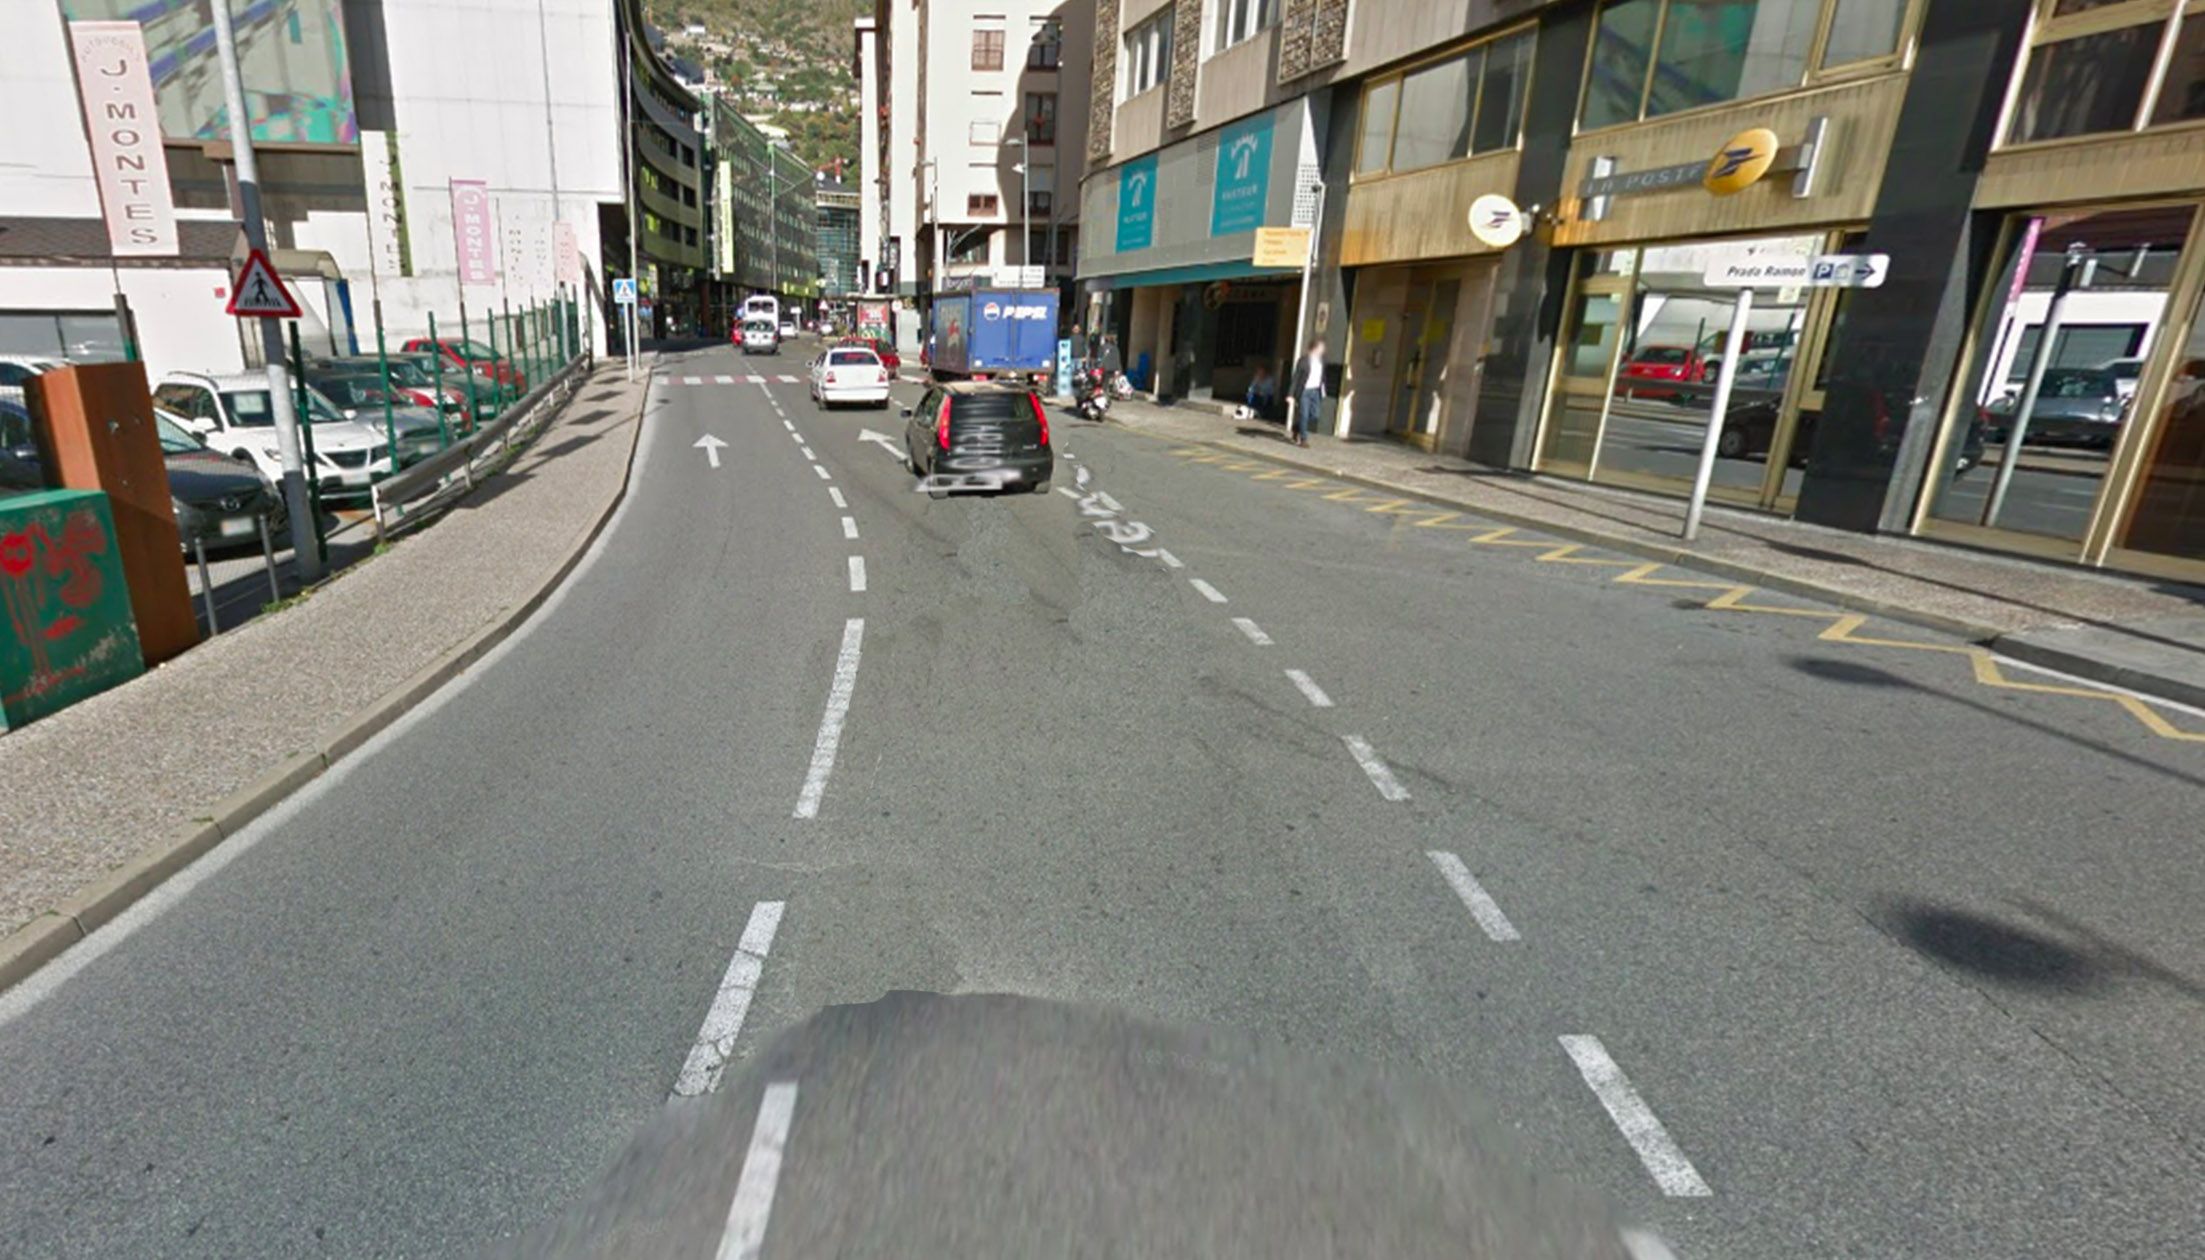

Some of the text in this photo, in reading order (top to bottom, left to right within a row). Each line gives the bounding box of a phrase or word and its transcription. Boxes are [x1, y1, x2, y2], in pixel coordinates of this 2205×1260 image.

[1727, 265, 1761, 277] Prada
[1764, 265, 1806, 277] Ramon
[1002, 305, 1048, 319] PEPSI
